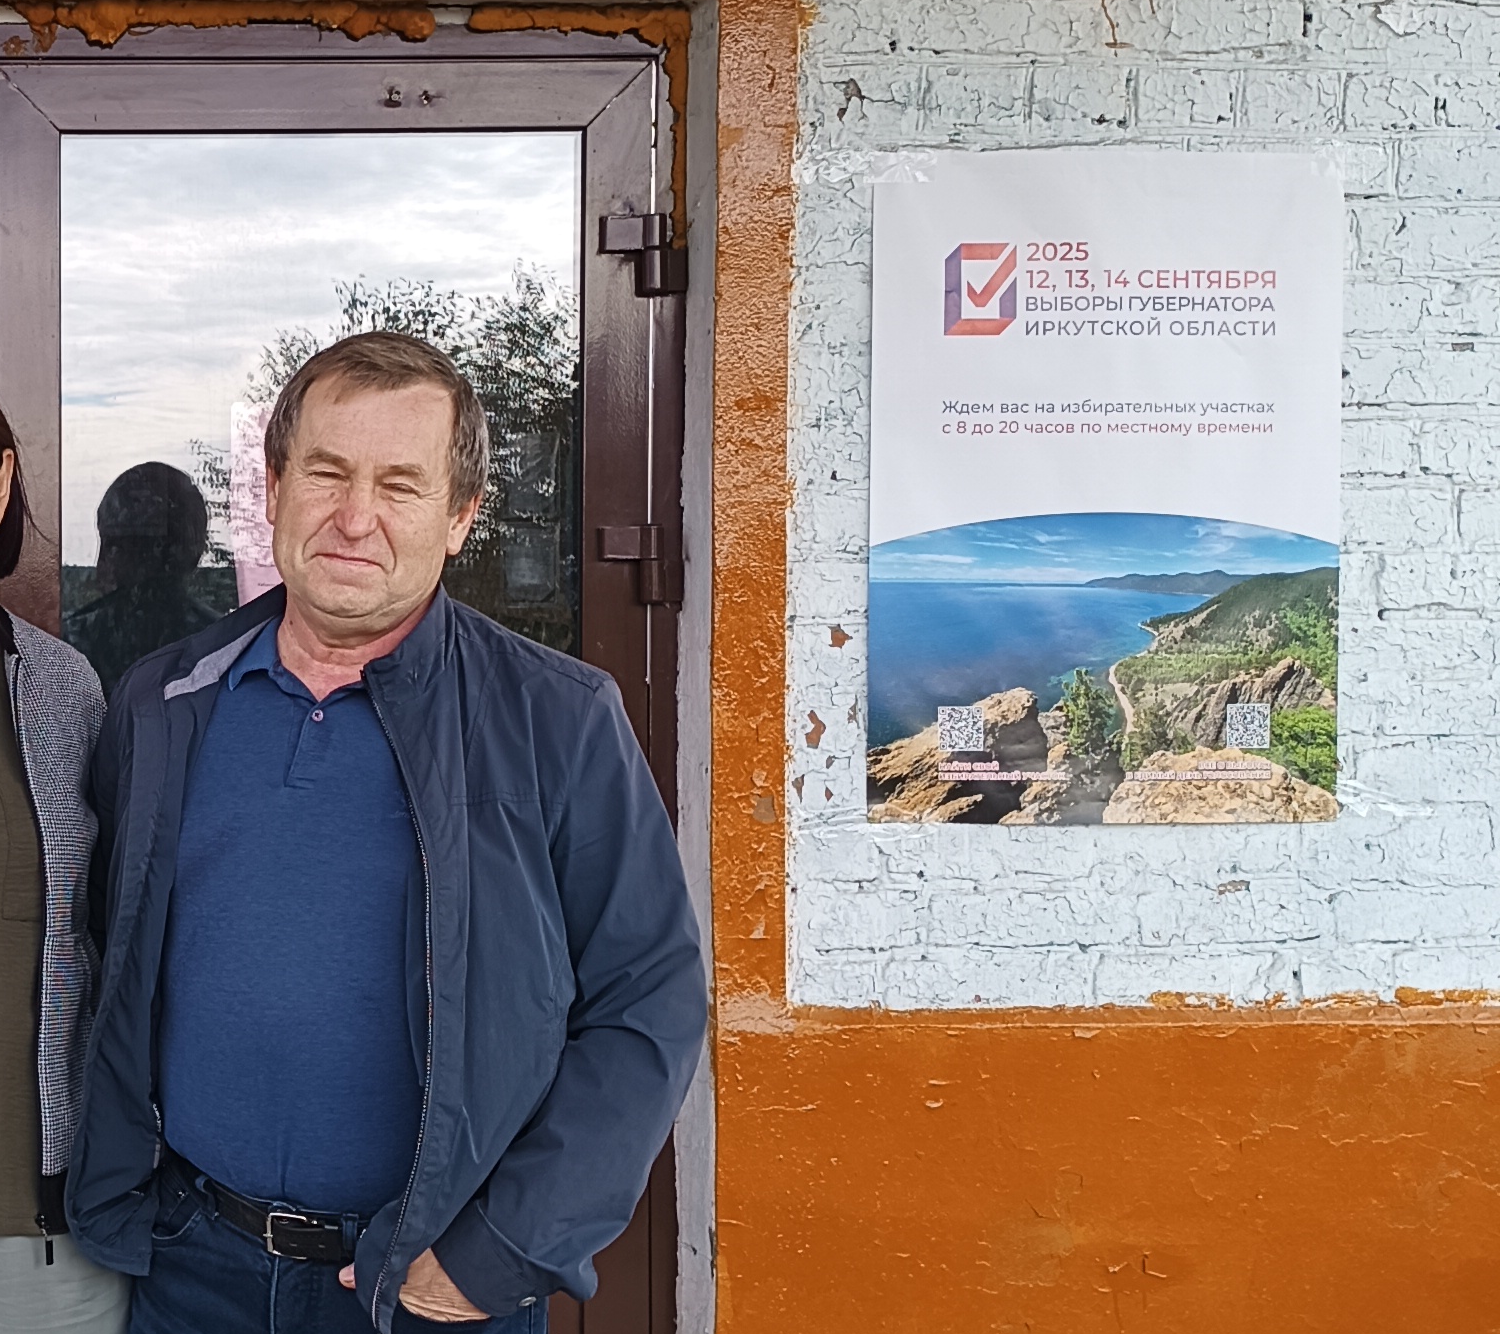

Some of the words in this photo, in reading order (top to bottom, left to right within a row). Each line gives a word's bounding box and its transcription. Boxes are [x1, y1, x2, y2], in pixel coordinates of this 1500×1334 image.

[1027, 242, 1089, 261] 2025
[1026, 270, 1056, 292] 12,
[1065, 270, 1095, 291] 13,
[1104, 270, 1130, 287] 14
[1138, 270, 1276, 288] СЕНТЯБРЯ
[1026, 296, 1122, 311] ВЫБОРЫ
[1129, 296, 1275, 311] ГУБЕРНАТОРА
[1026, 317, 1160, 335] ИРКУТСКОЙ
[1170, 321, 1275, 336] ОБЛАСТИ
[943, 401, 993, 415] Ждем
[1001, 403, 1029, 413] вас
[1035, 404, 1054, 413] на
[1061, 399, 1195, 416] избирательных
[1200, 403, 1274, 416] участках
[943, 424, 951, 433] с
[957, 421, 966, 433] 8
[972, 424, 993, 435] до
[999, 421, 1019, 433] 20
[1025, 424, 1074, 433] часов
[1081, 424, 1101, 433] по
[1108, 424, 1191, 436] местному
[1198, 423, 1272, 435] времени
